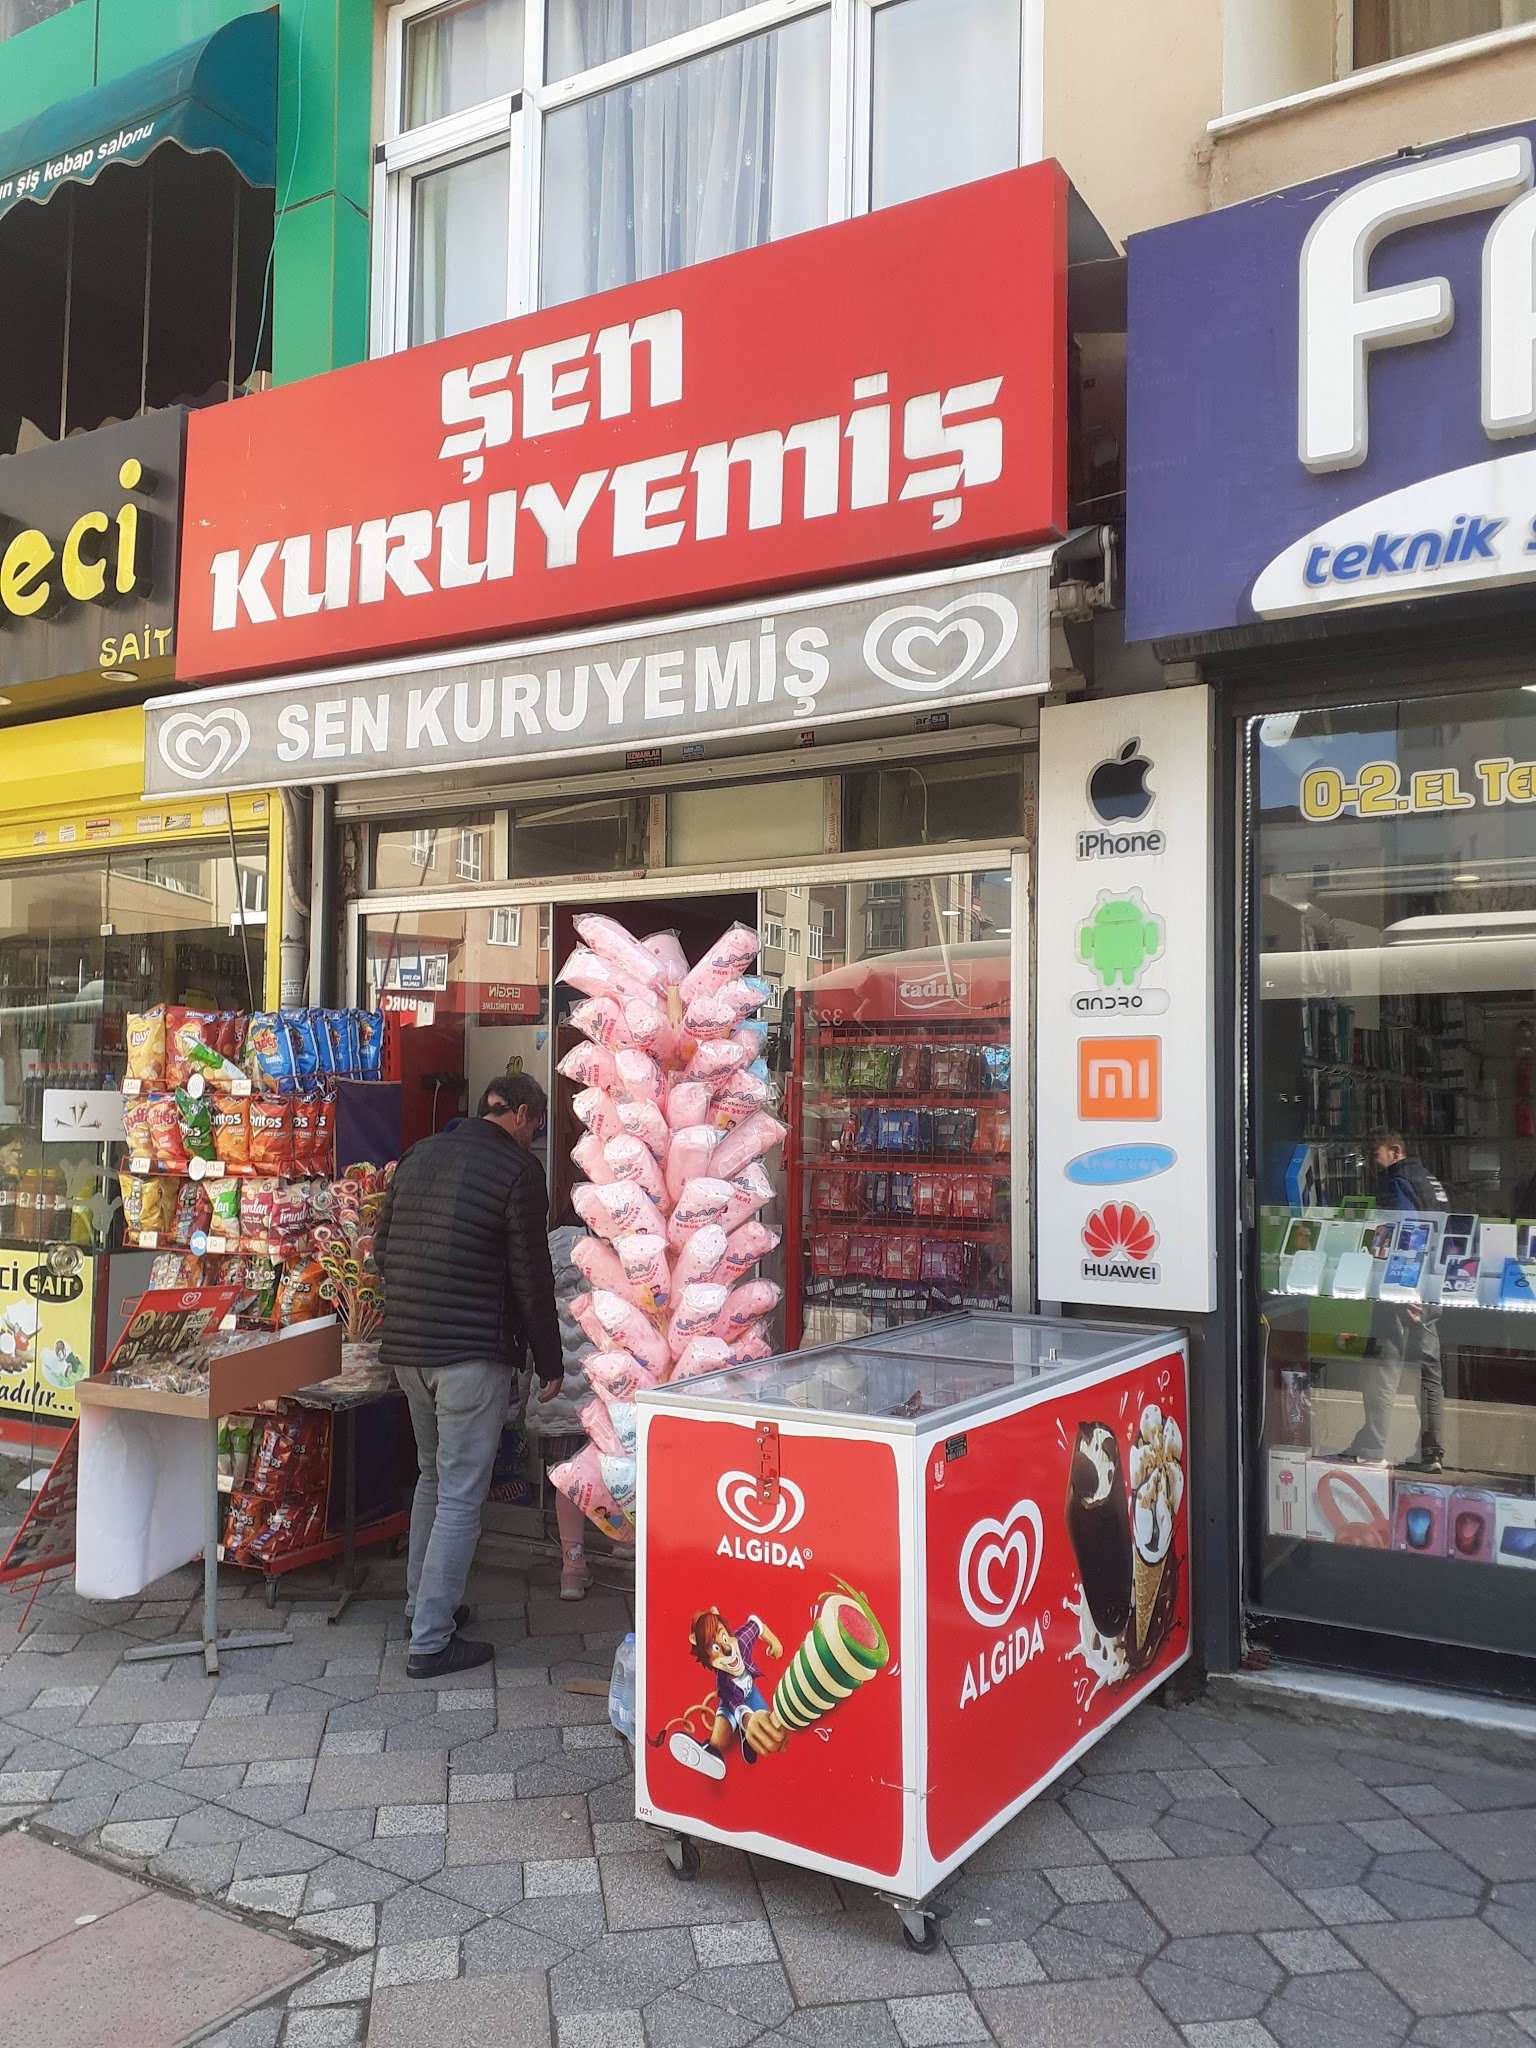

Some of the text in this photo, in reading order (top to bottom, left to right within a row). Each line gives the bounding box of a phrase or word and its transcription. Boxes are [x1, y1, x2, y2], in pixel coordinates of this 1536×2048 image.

[16, 168, 41, 198] şiş
[43, 149, 94, 183] kebap
[97, 122, 155, 160] salonu
[438, 308, 684, 485] ŞEN
[209, 371, 1004, 632] KURUYEMİŞ
[1305, 515, 1503, 587] teknik
[100, 623, 173, 668] SAİT
[277, 617, 830, 762] SEN KURUYEMİŞ
[626, 749, 660, 760] UZMANLAR
[1078, 832, 1161, 858] iPhone
[900, 980, 967, 998] tadım
[29, 1272, 75, 1298] SAİT
[1084, 1263, 1156, 1280] HUAWEI
